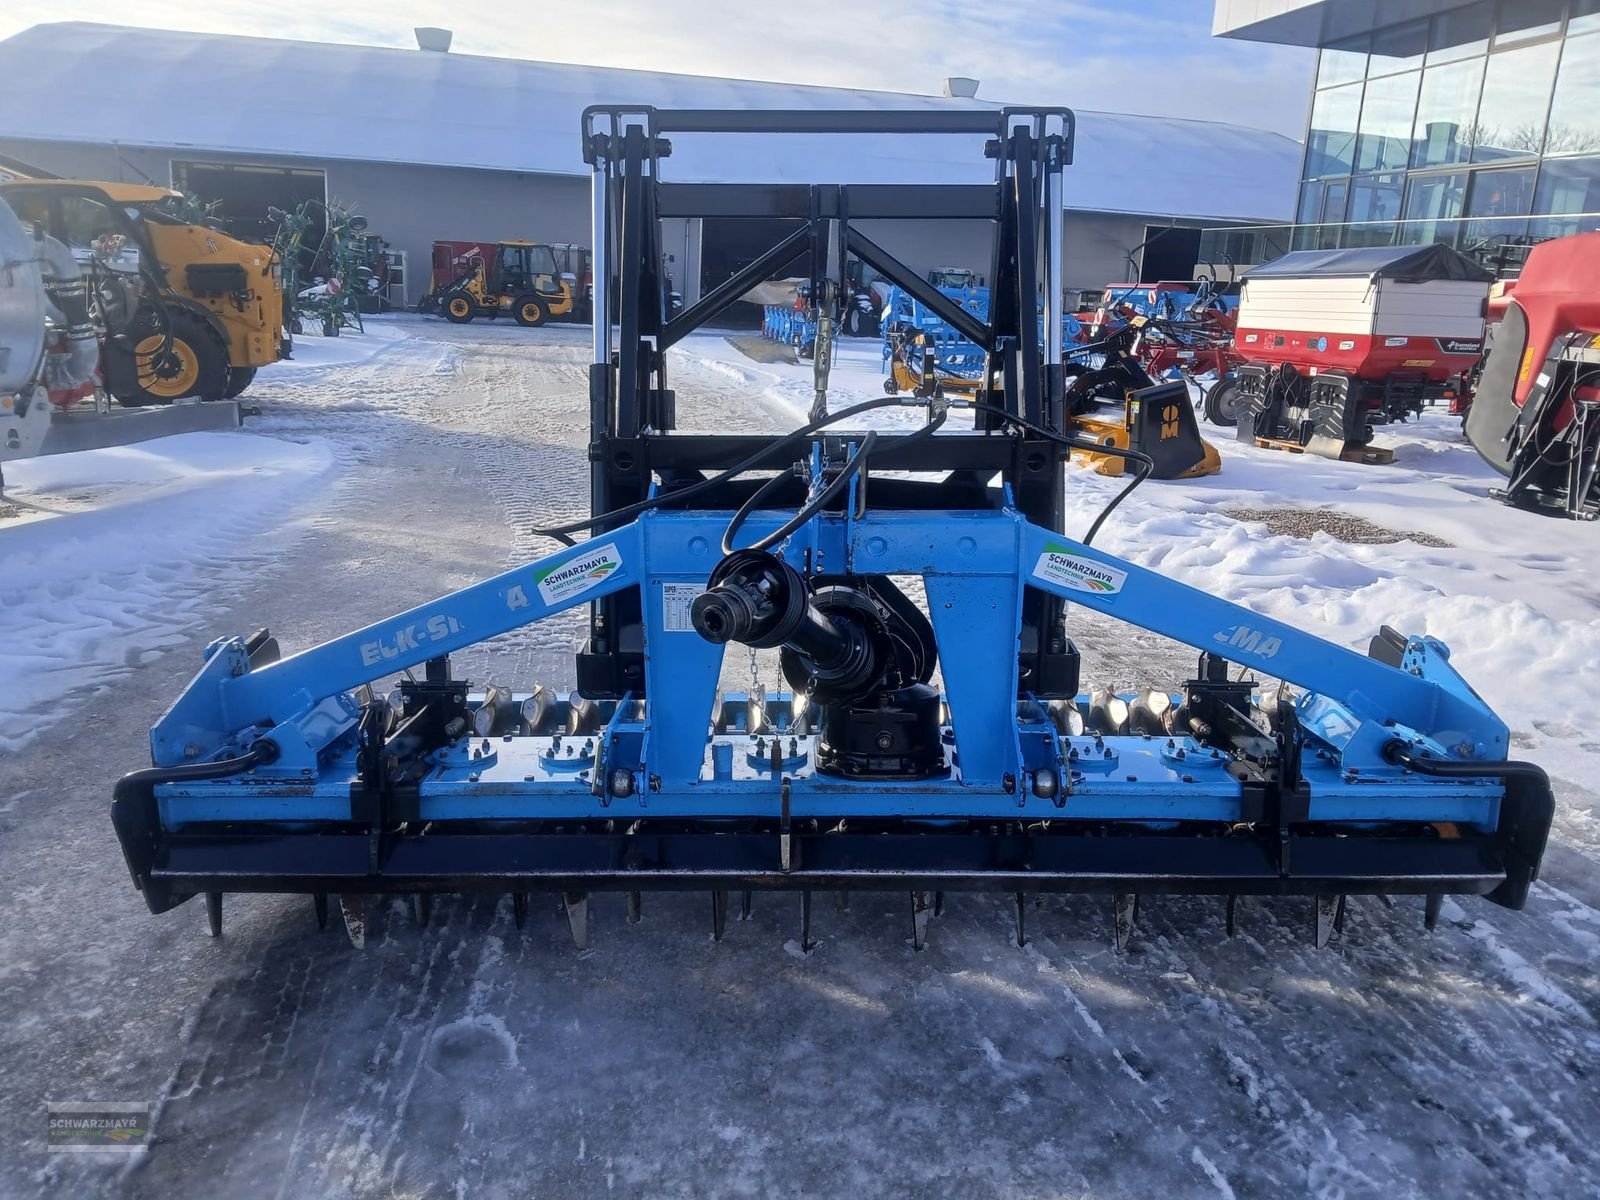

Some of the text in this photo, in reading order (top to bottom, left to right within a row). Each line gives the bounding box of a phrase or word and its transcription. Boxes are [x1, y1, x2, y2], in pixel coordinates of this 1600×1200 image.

[544, 556, 609, 587] SCHWARZMAYR
[1046, 562, 1084, 581] LANDTECHNIK
[1048, 553, 1113, 584] SCHWARZMAYR
[549, 575, 587, 593] LANDTECHNIK
